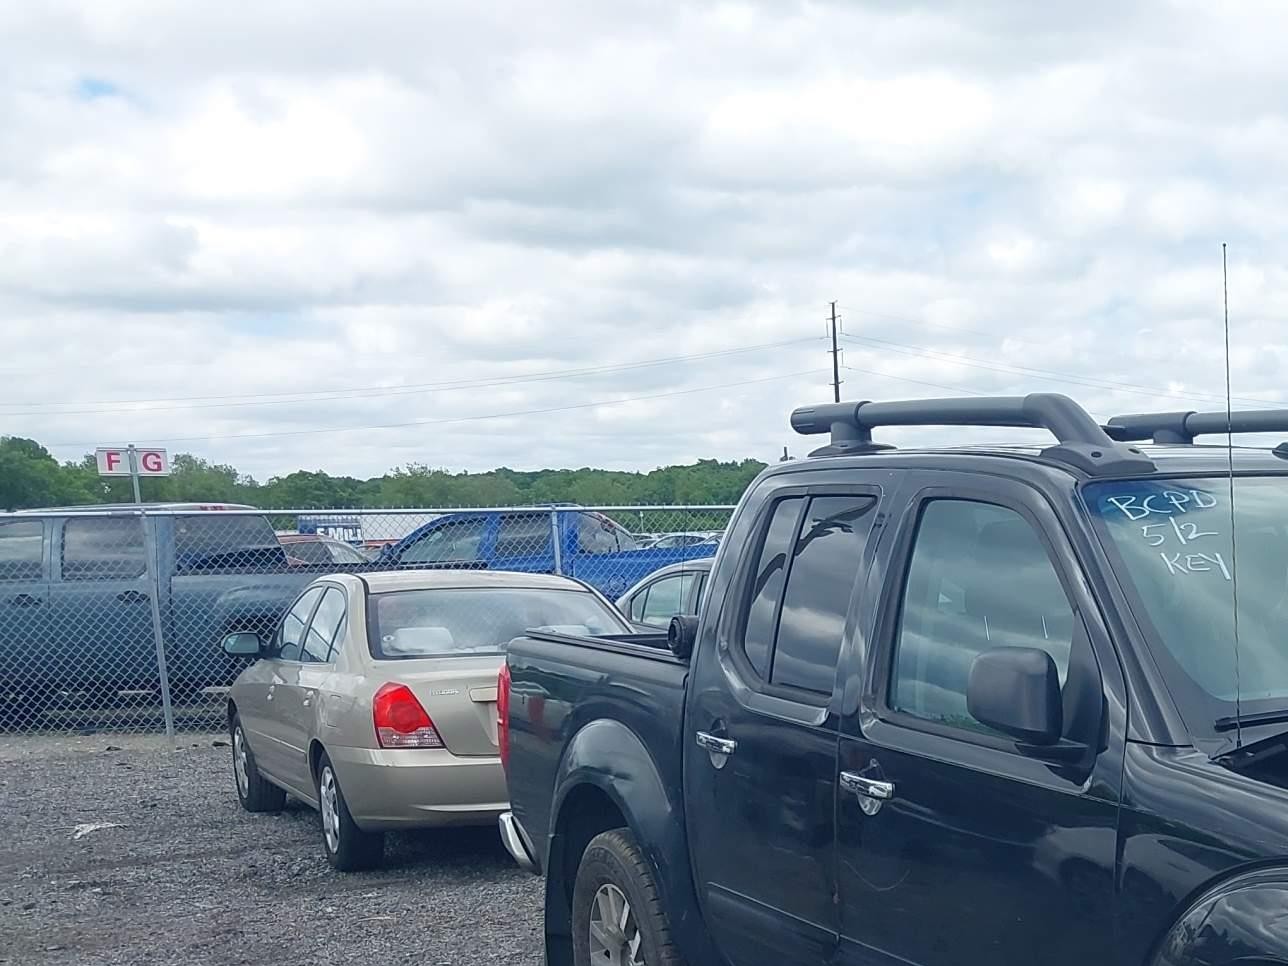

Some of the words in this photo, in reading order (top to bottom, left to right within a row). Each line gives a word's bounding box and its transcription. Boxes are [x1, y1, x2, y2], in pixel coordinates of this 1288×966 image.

[106, 452, 120, 471] F
[142, 453, 162, 472] G
[1108, 489, 1217, 520] BCPD
[1160, 552, 1232, 580] KEY
